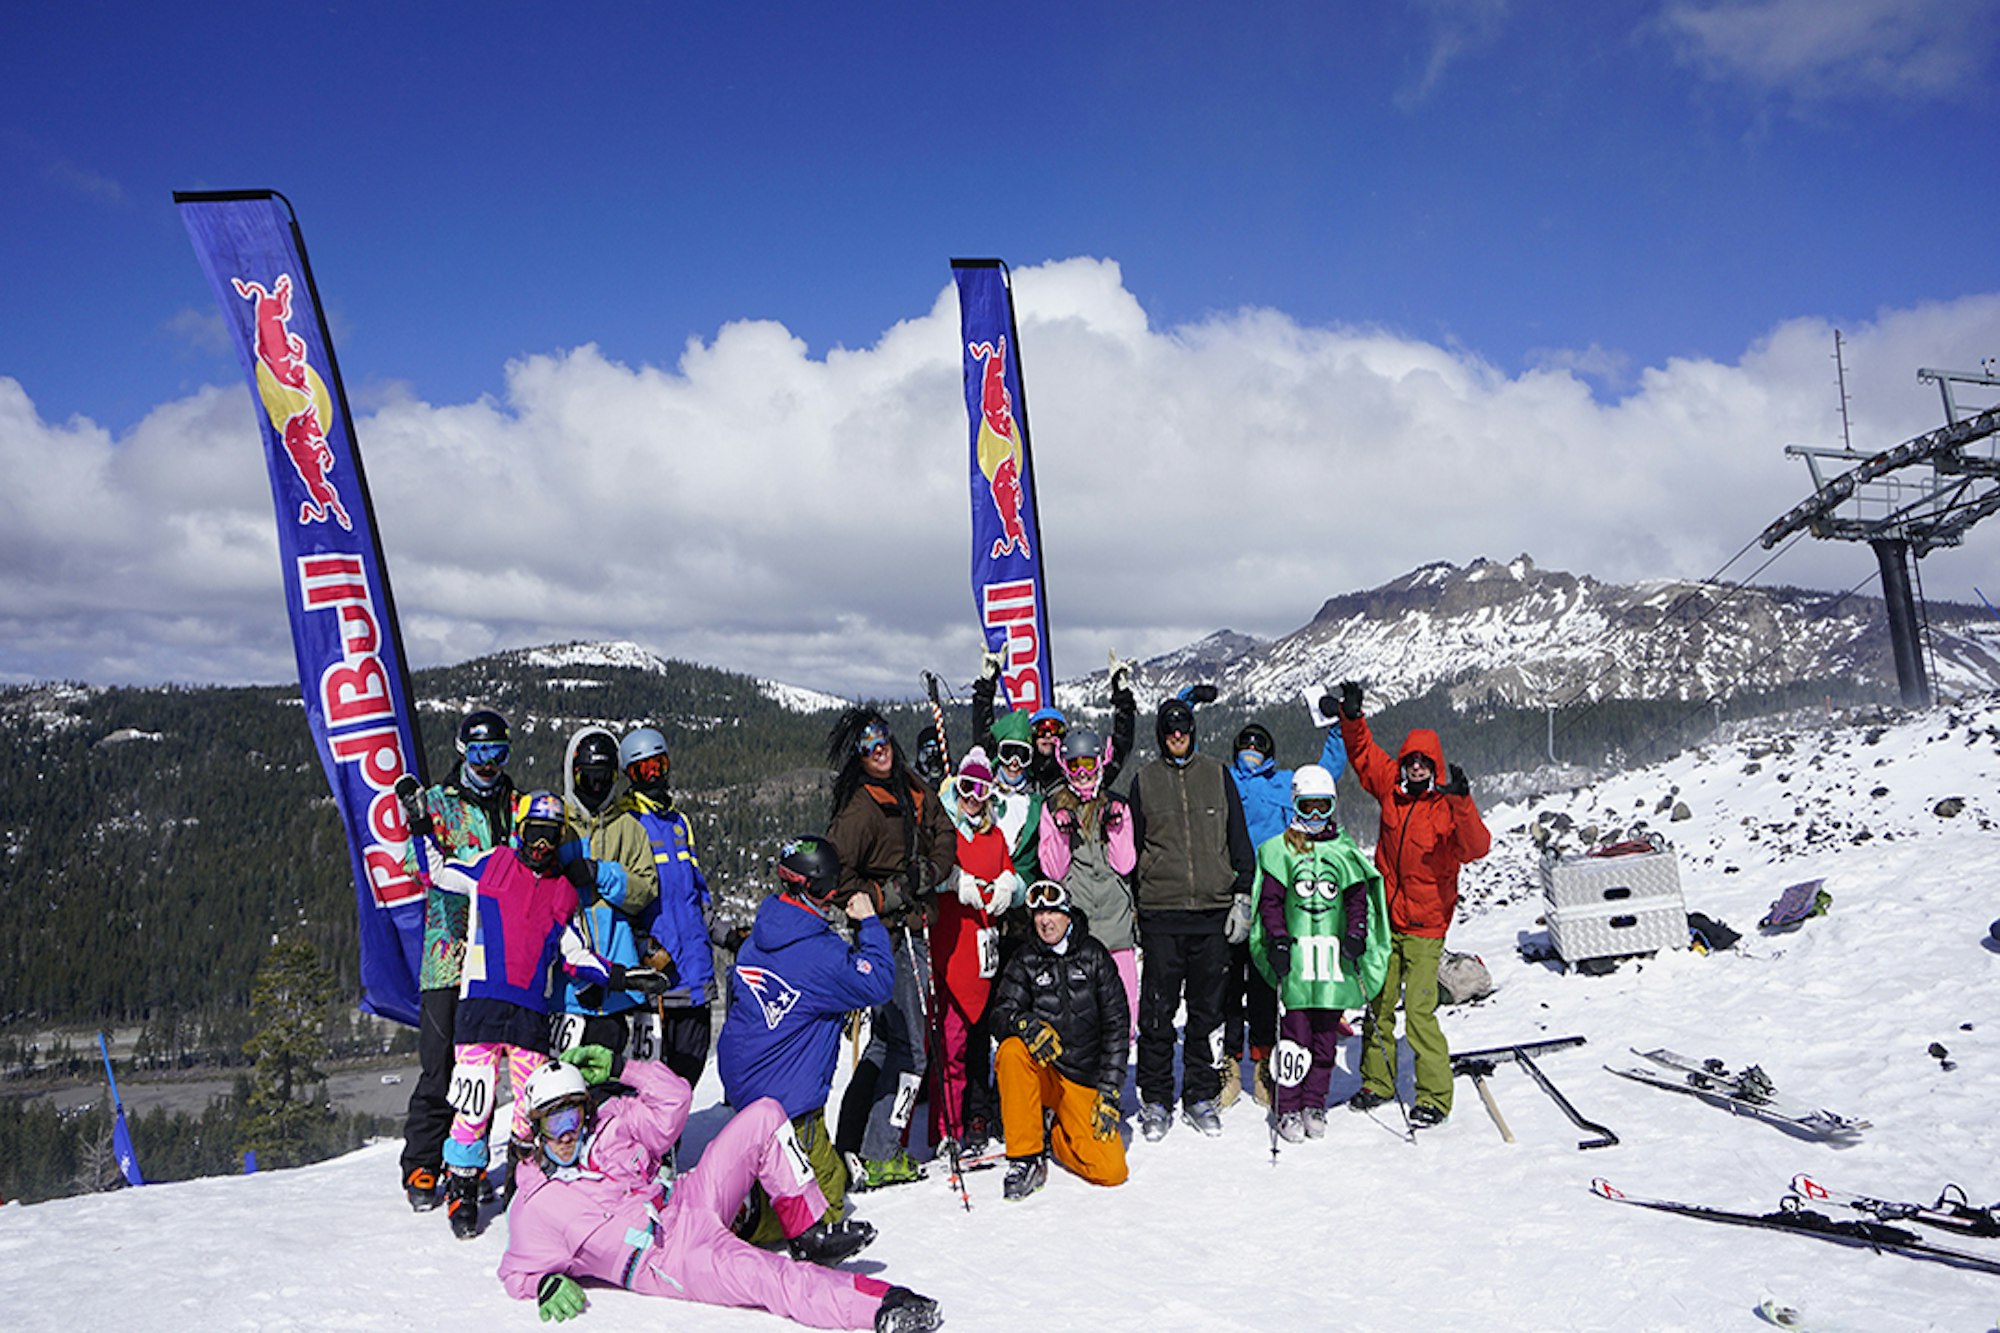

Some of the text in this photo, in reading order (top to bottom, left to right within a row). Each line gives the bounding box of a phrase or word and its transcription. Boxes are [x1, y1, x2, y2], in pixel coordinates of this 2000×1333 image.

[984, 579, 1042, 718] Bull
[298, 554, 427, 907] Red Bull
[453, 1077, 486, 1117] 220
[1278, 1050, 1304, 1081] 196
